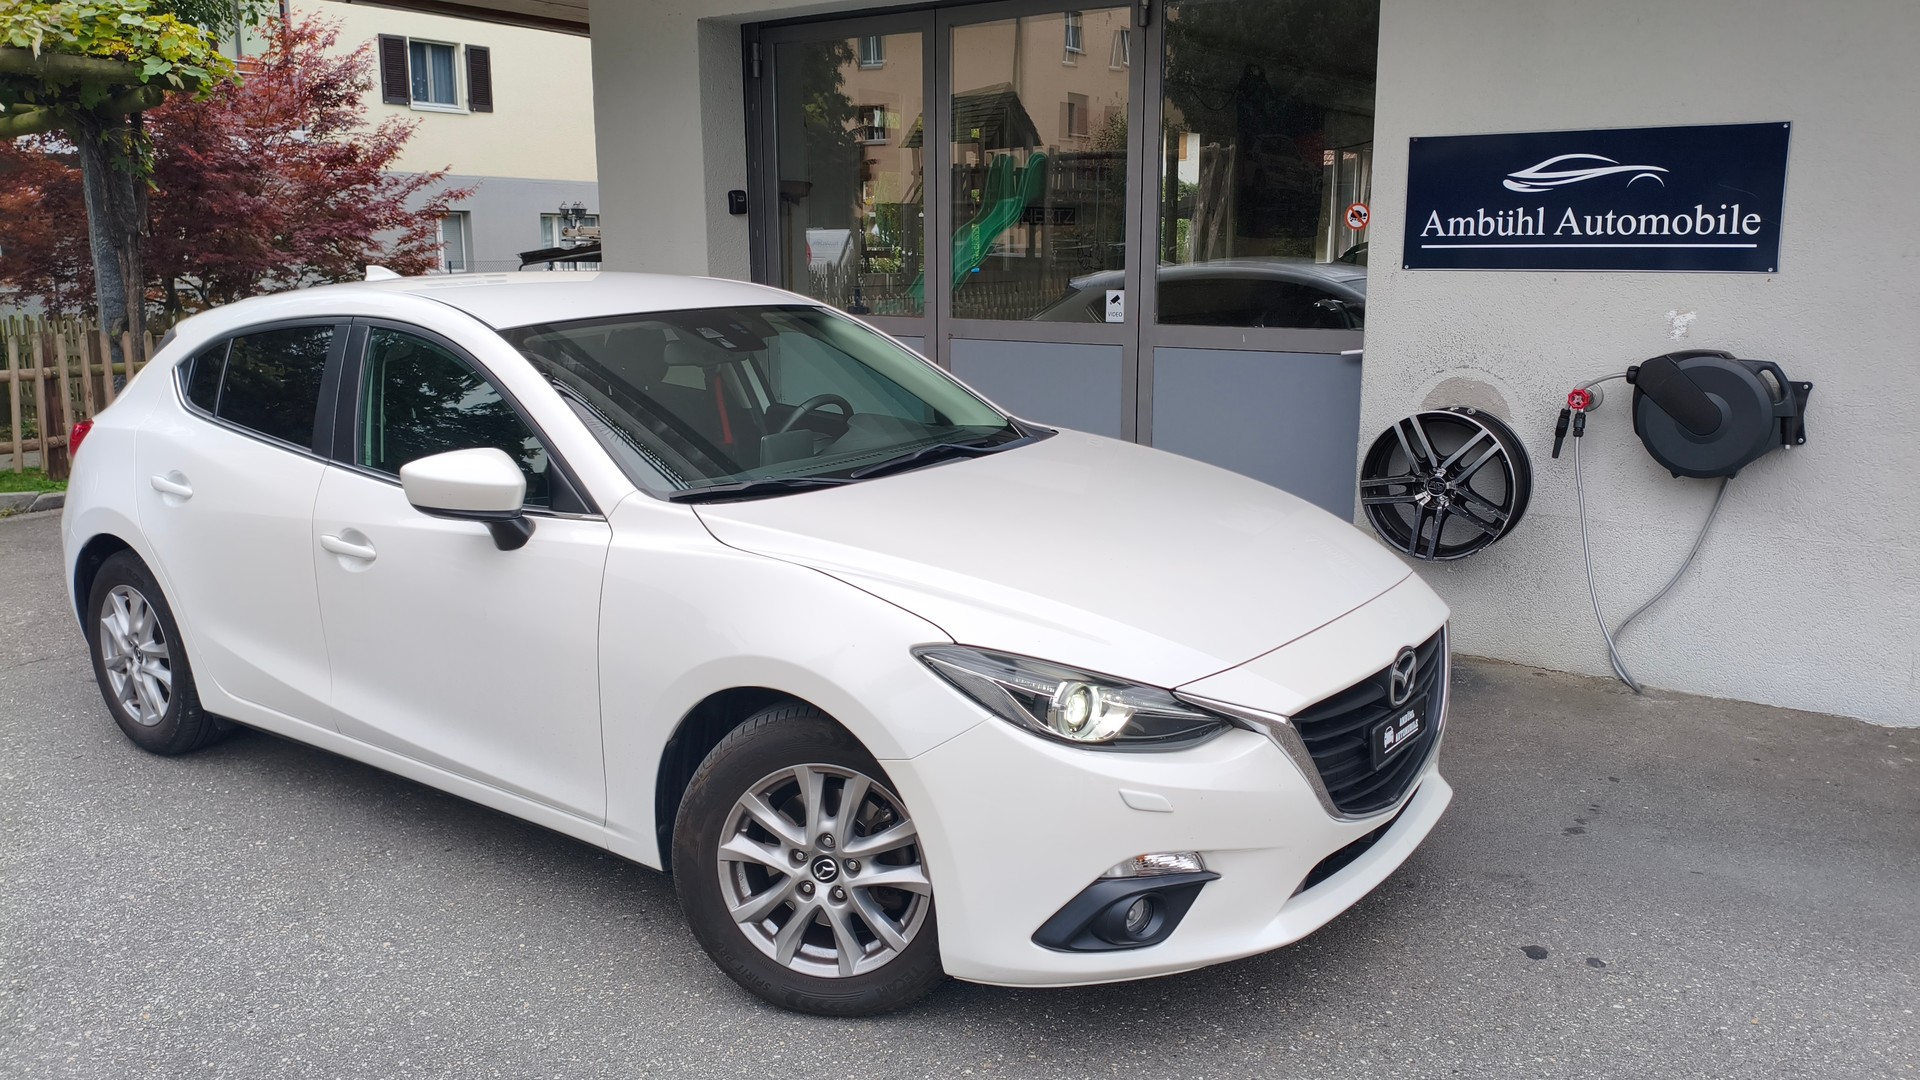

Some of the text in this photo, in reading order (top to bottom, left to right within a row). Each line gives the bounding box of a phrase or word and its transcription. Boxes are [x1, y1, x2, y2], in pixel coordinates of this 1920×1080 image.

[1021, 208, 1074, 224] HERTZ
[1420, 203, 1761, 238] Ambühl Automobile
[734, 964, 772, 991] SPIRIT
